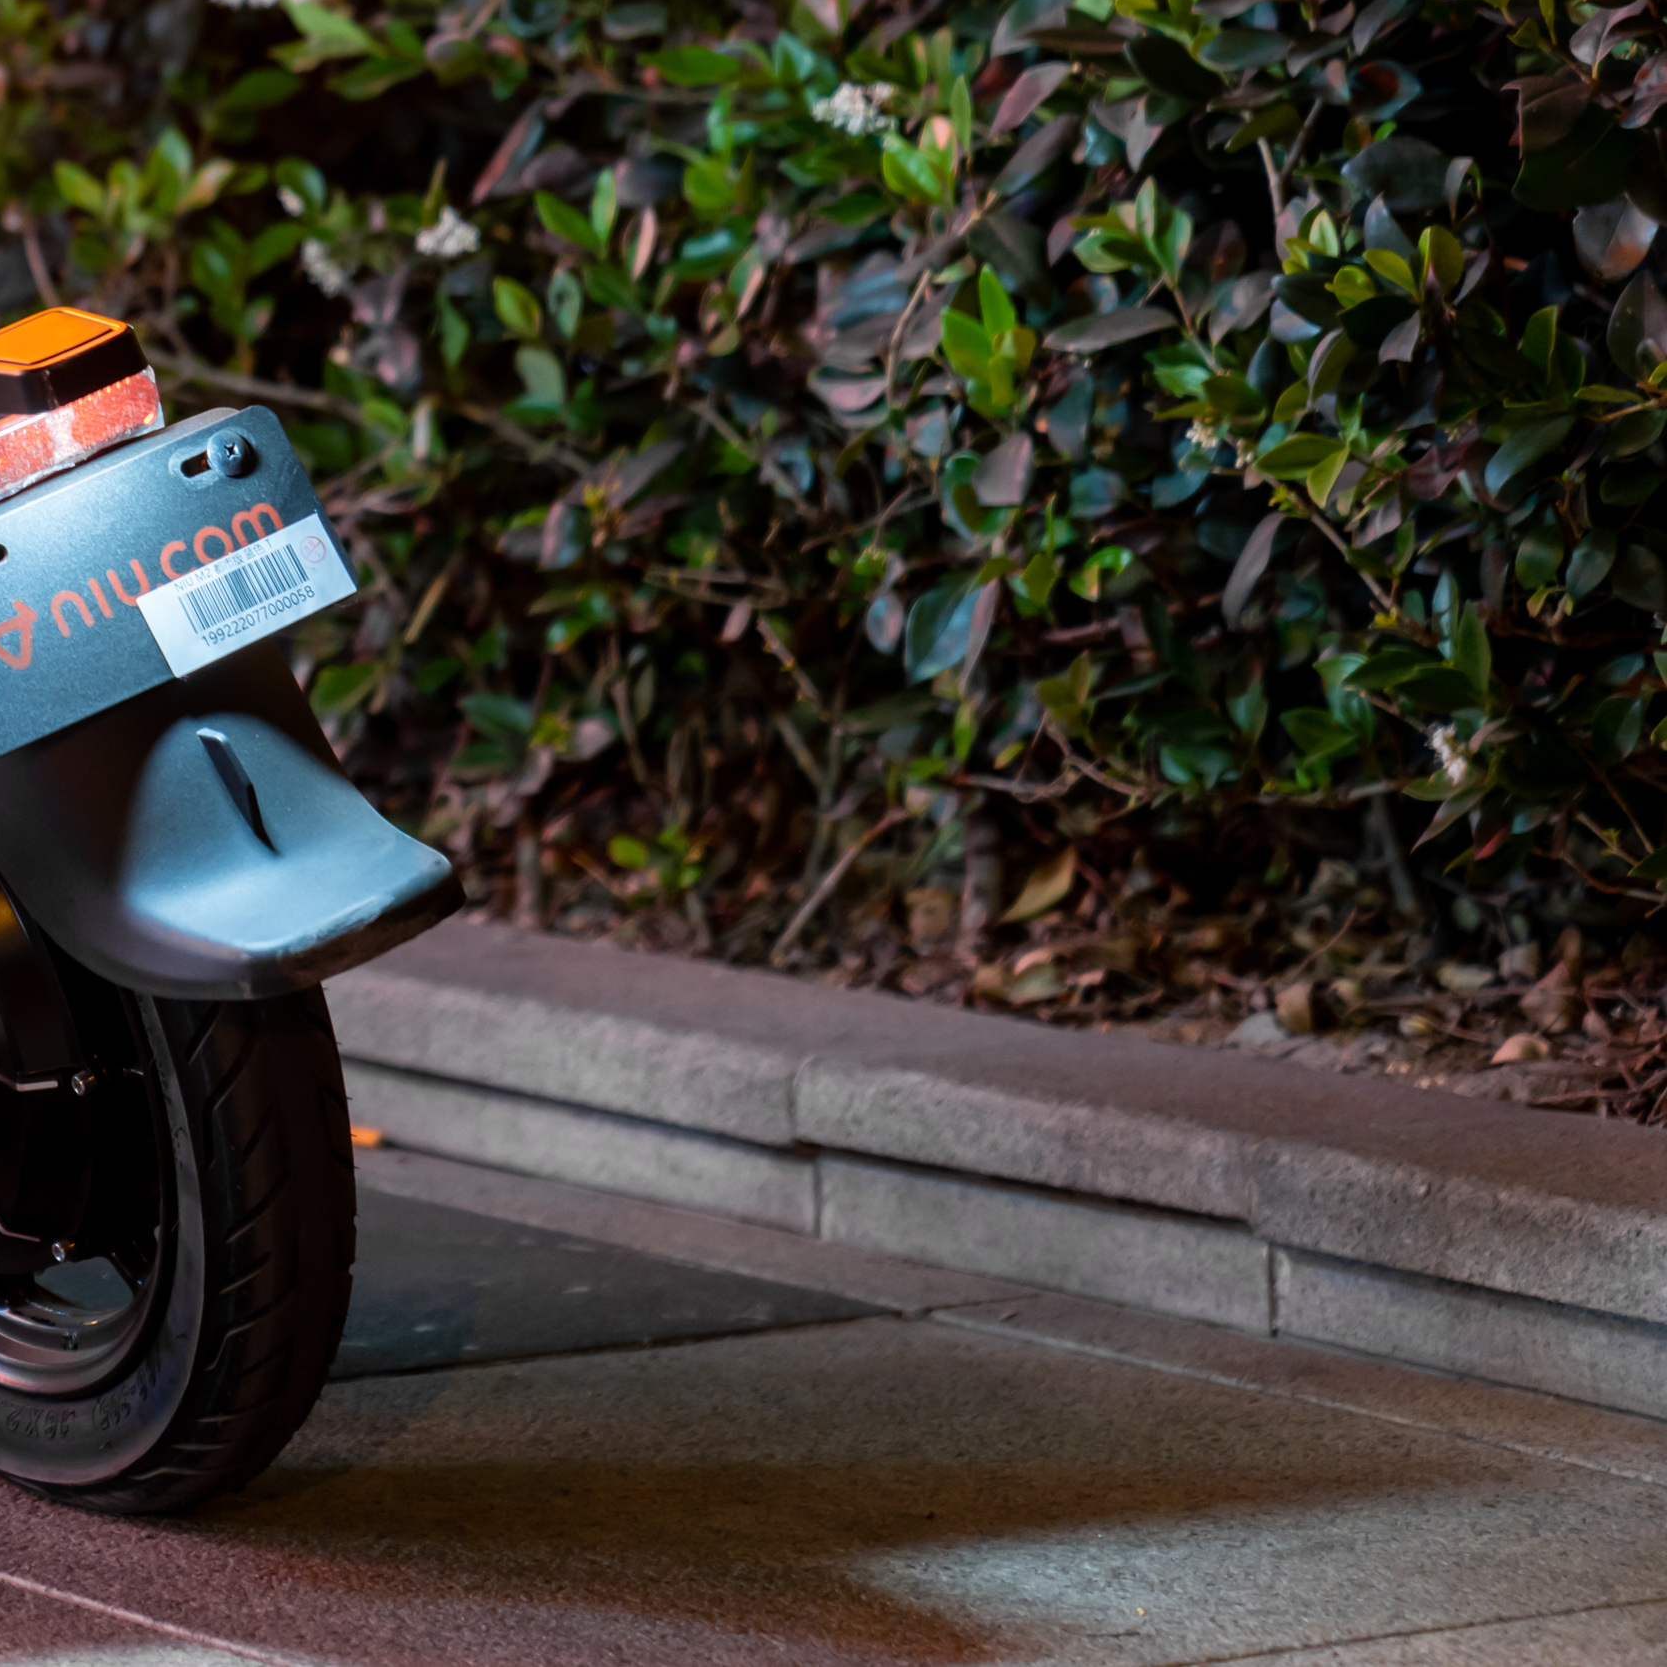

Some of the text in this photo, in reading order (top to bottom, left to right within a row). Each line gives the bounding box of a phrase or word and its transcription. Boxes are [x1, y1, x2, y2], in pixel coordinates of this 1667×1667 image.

[174, 577, 194, 593] NIU
[195, 567, 214, 583] M2
[201, 585, 316, 648] 199222077000058
